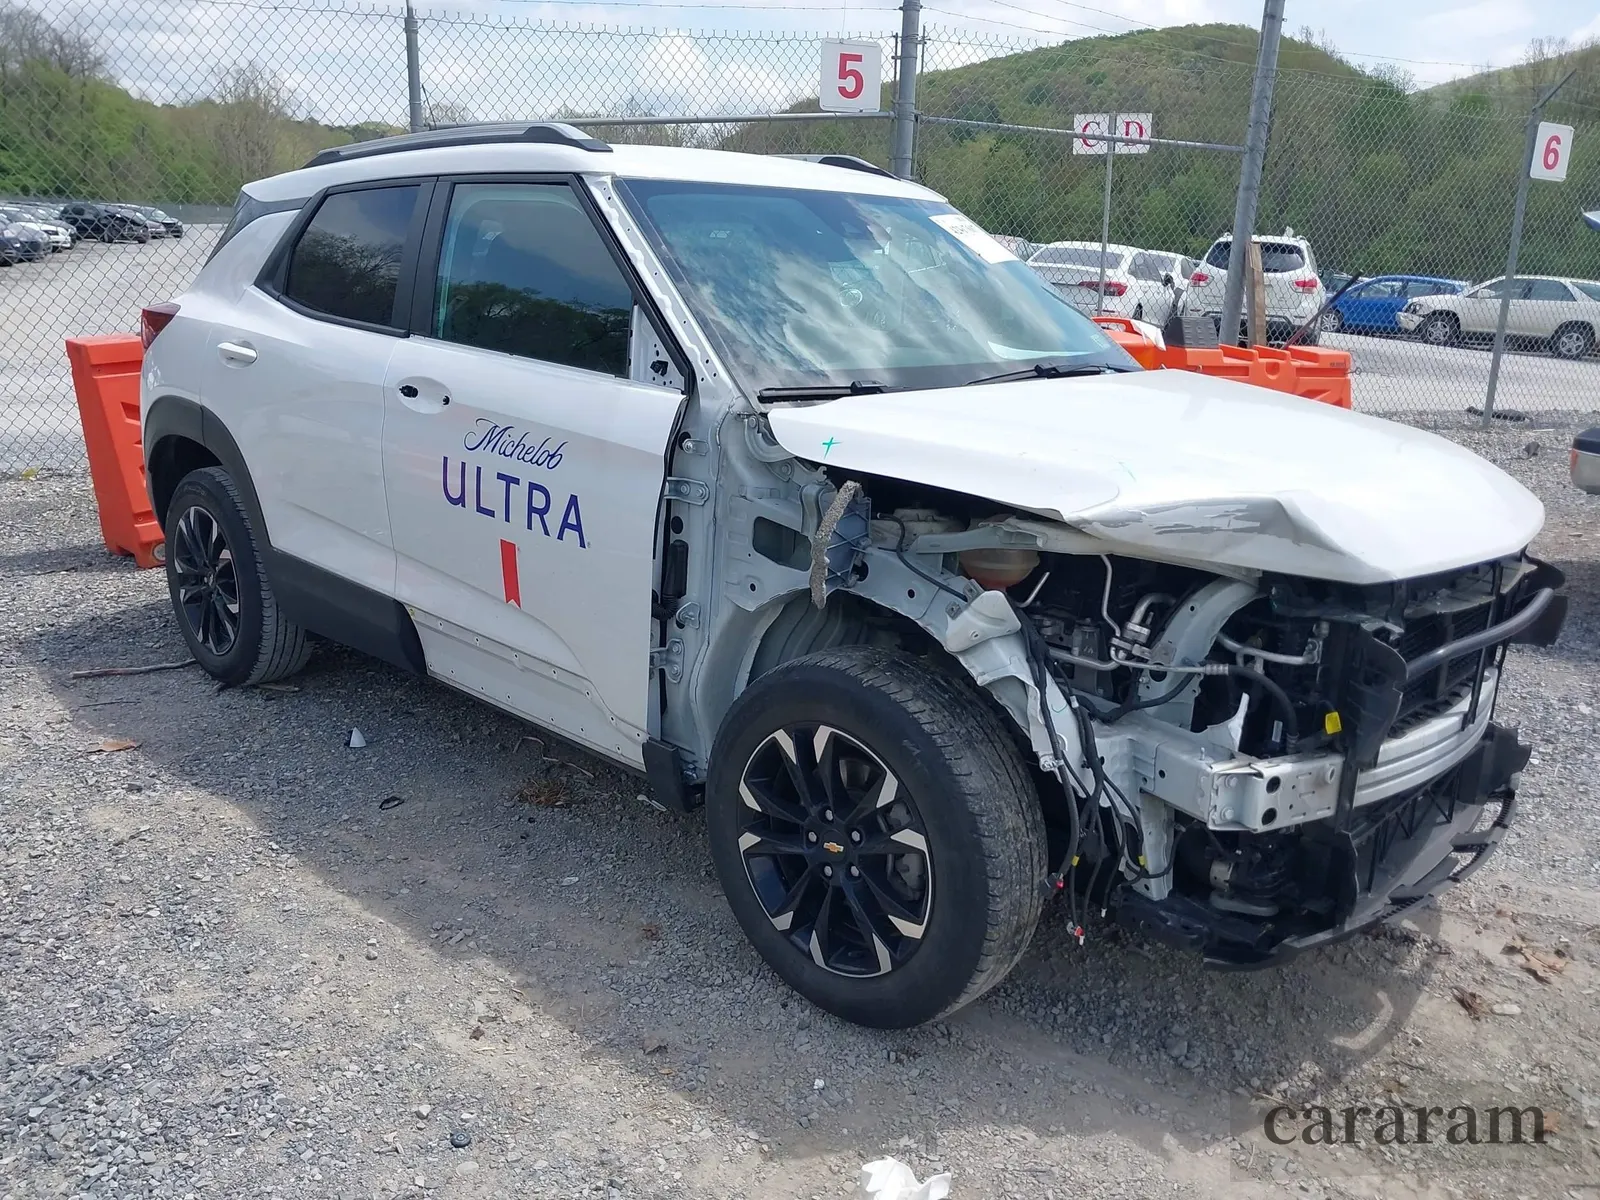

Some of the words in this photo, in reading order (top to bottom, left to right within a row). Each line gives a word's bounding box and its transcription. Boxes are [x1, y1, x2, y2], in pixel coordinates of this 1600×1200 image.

[838, 53, 864, 99] 5
[1082, 121, 1101, 148] C
[1124, 121, 1144, 147] D
[1543, 135, 1562, 170] 6
[463, 417, 569, 470] Michelob
[442, 456, 587, 549] ULTRA
